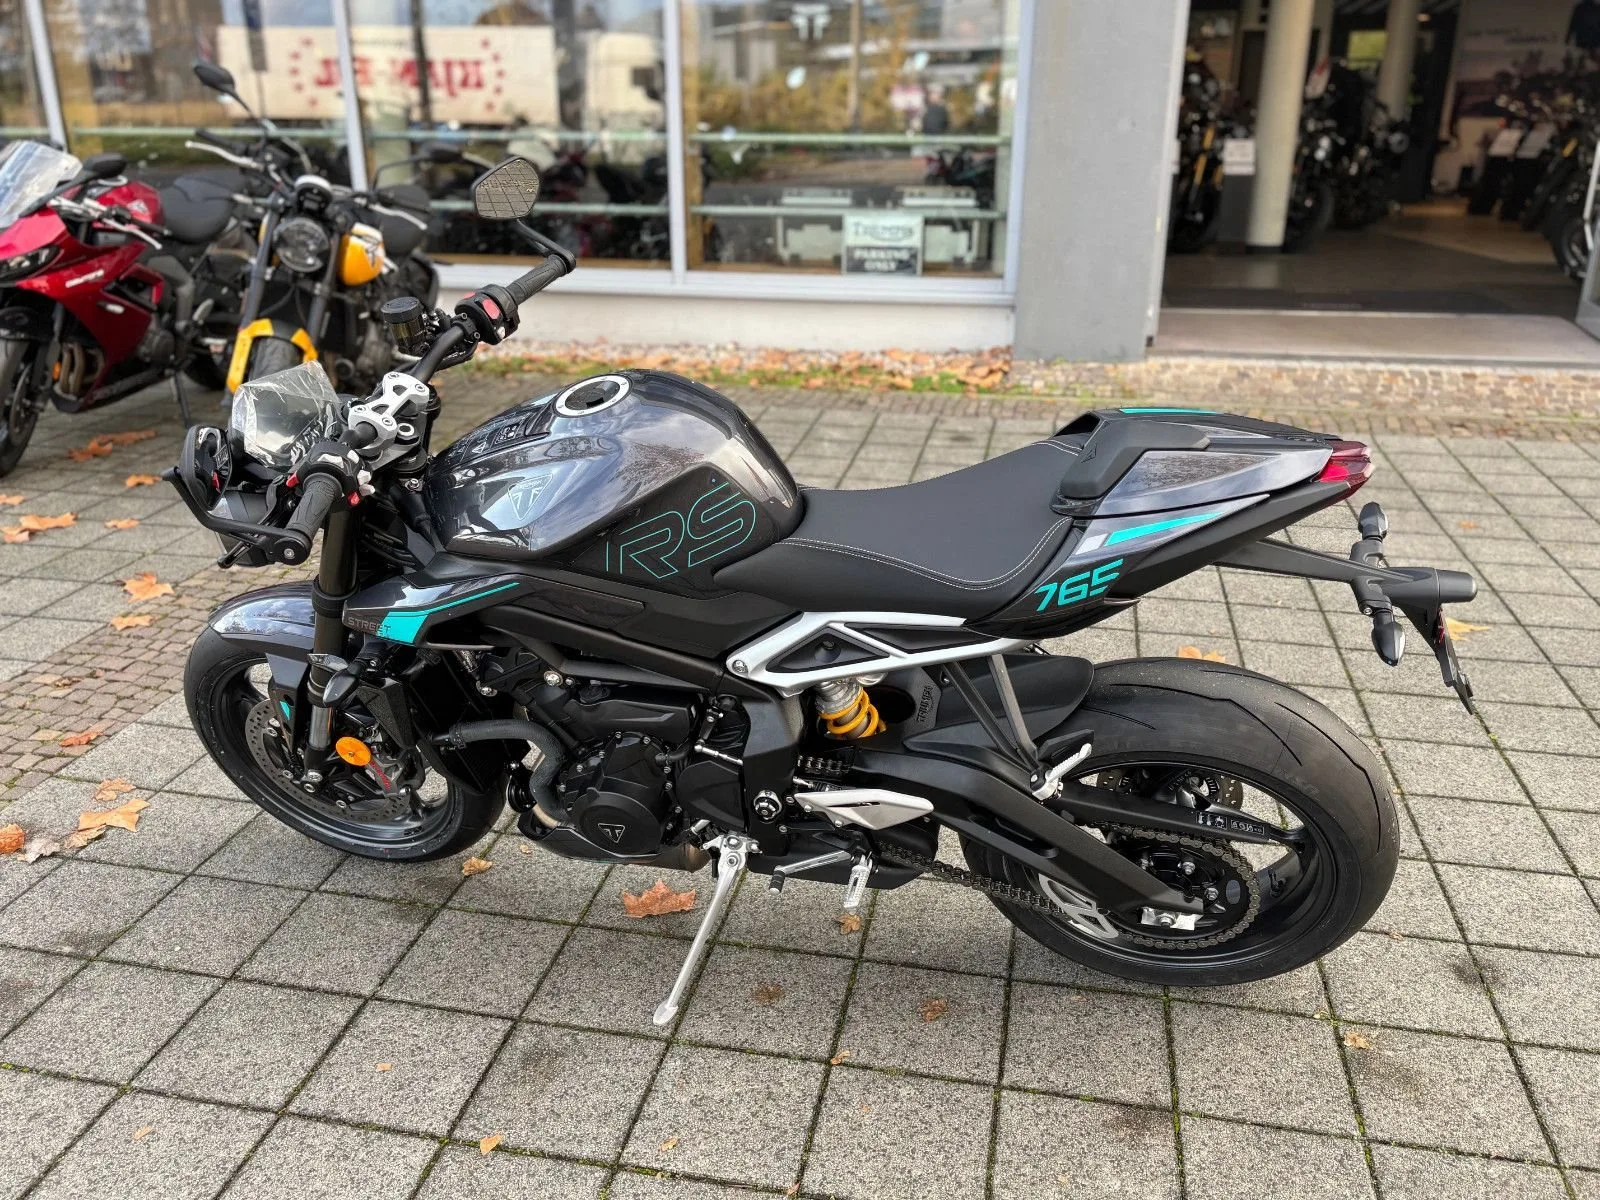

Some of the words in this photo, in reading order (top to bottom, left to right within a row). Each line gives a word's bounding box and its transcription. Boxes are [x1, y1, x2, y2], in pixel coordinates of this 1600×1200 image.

[605, 480, 757, 579] RS
[1033, 558, 1124, 612] 765
[347, 616, 392, 636] STREET
